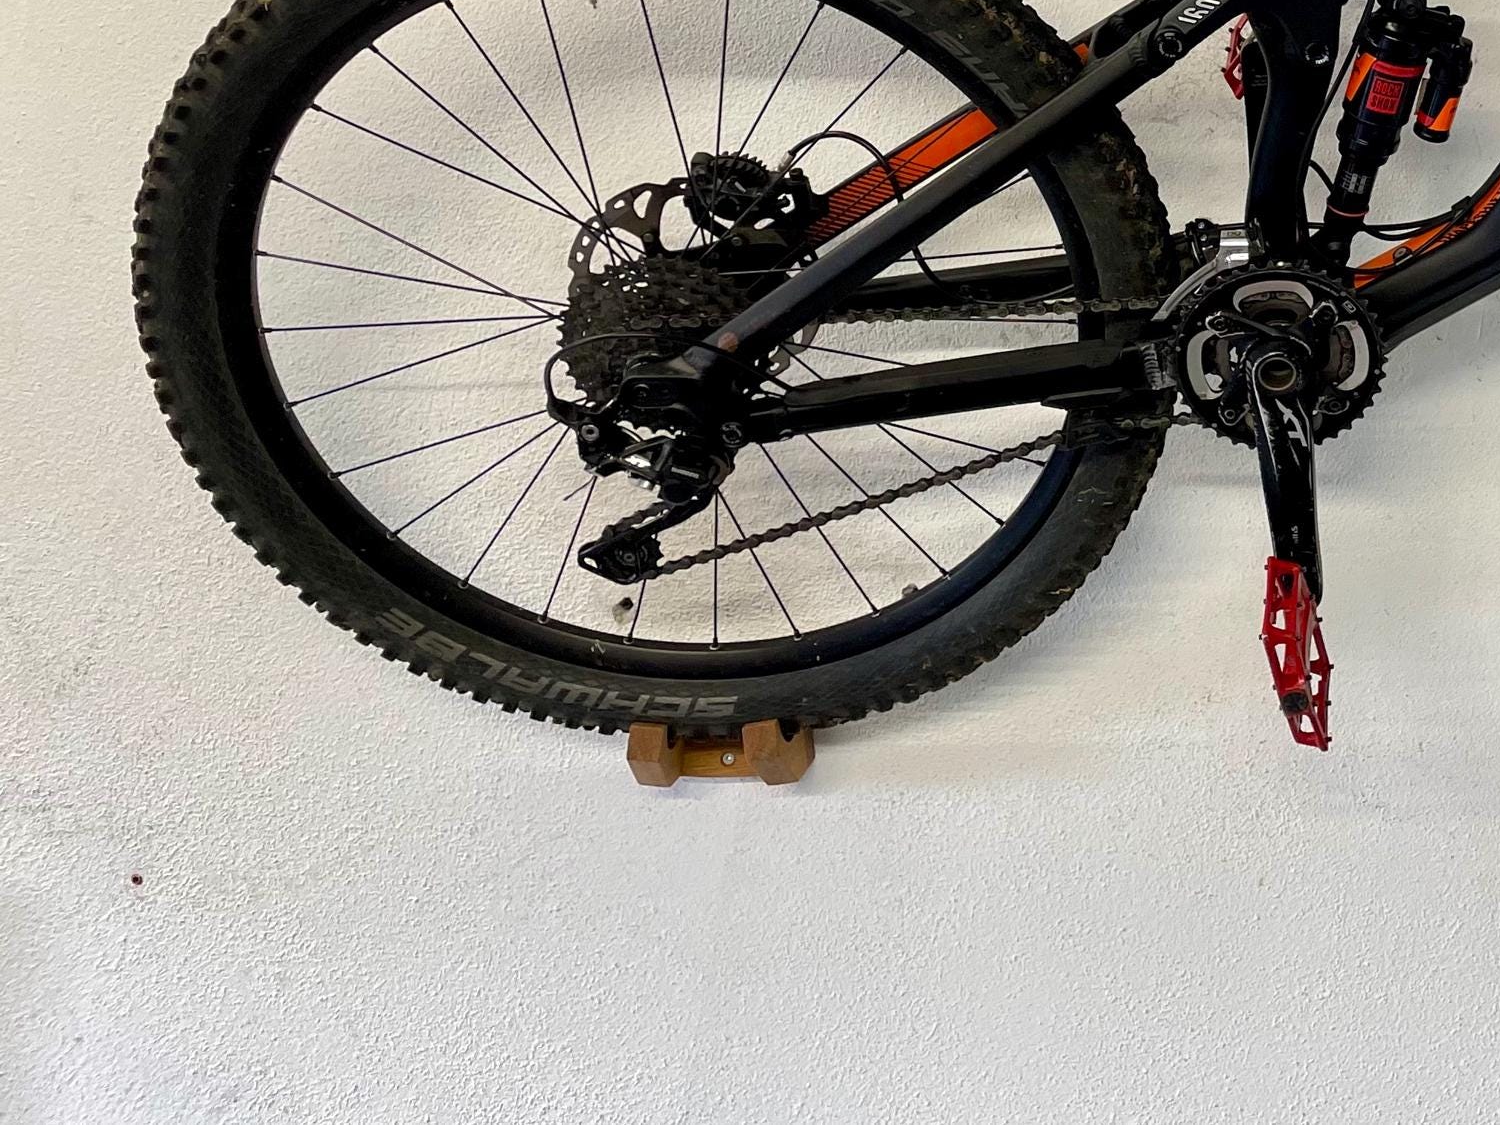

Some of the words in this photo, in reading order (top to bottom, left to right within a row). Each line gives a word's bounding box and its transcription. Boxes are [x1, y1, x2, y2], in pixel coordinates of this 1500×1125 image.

[1369, 94, 1398, 111] SHOX
[1374, 79, 1402, 97] ROCK
[1275, 398, 1308, 447] XT
[375, 607, 738, 718] SCHWALBE
